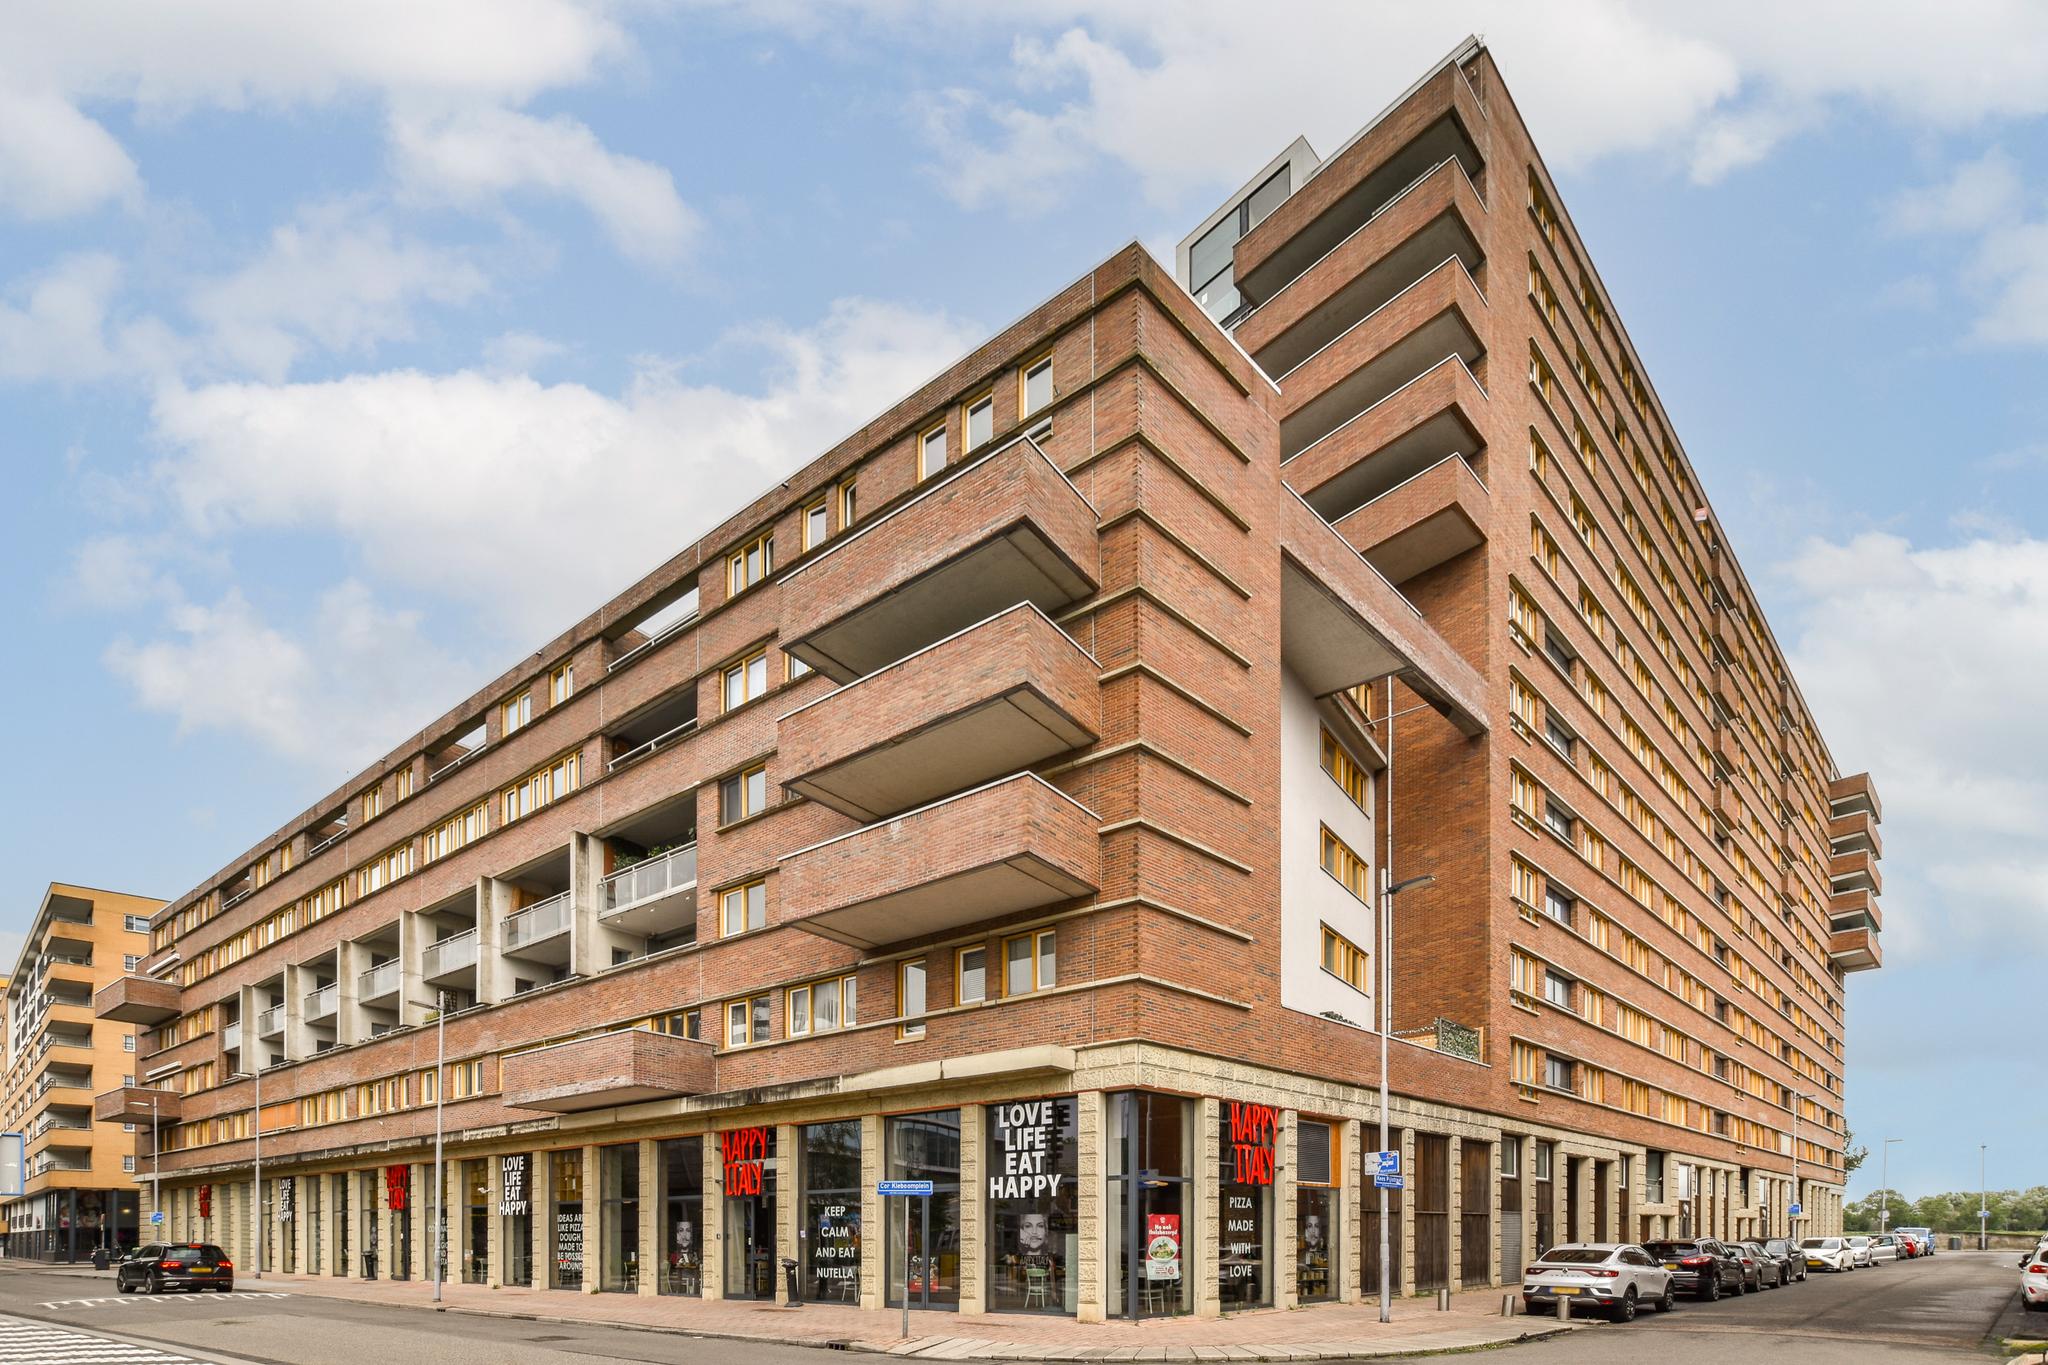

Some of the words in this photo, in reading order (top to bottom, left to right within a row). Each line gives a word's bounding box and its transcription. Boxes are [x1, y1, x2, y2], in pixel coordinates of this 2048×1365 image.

[999, 1101, 1053, 1128] LOVE
[1231, 1102, 1279, 1144] HAPPY
[721, 1127, 767, 1163] HAPPY
[1004, 1126, 1046, 1151] LIFE
[502, 1156, 524, 1171] LOVE
[1005, 1150, 1045, 1175] EAT
[1235, 1143, 1275, 1185] ITALY
[504, 1171, 522, 1186] LIFE
[724, 1161, 764, 1196] ITALY
[505, 1186, 520, 1200] EAT
[989, 1173, 1062, 1199] HAPPY
[499, 1200, 527, 1216] HAPPY
[1229, 1197, 1253, 1209] PIZZA
[557, 1214, 573, 1223] IDEAS
[824, 1206, 846, 1217] KEEP
[557, 1223, 569, 1232] LIKE
[569, 1223, 583, 1232] PIZZA
[821, 1226, 849, 1238] CALM
[1228, 1219, 1254, 1232] MADE
[558, 1242, 575, 1251] MADE
[576, 1242, 583, 1251] TO
[815, 1247, 836, 1258] AND
[838, 1247, 855, 1258] EAT
[1230, 1242, 1252, 1255] WITH
[816, 1266, 854, 1279] NUTELLA
[1229, 1265, 1253, 1278] LOVE
